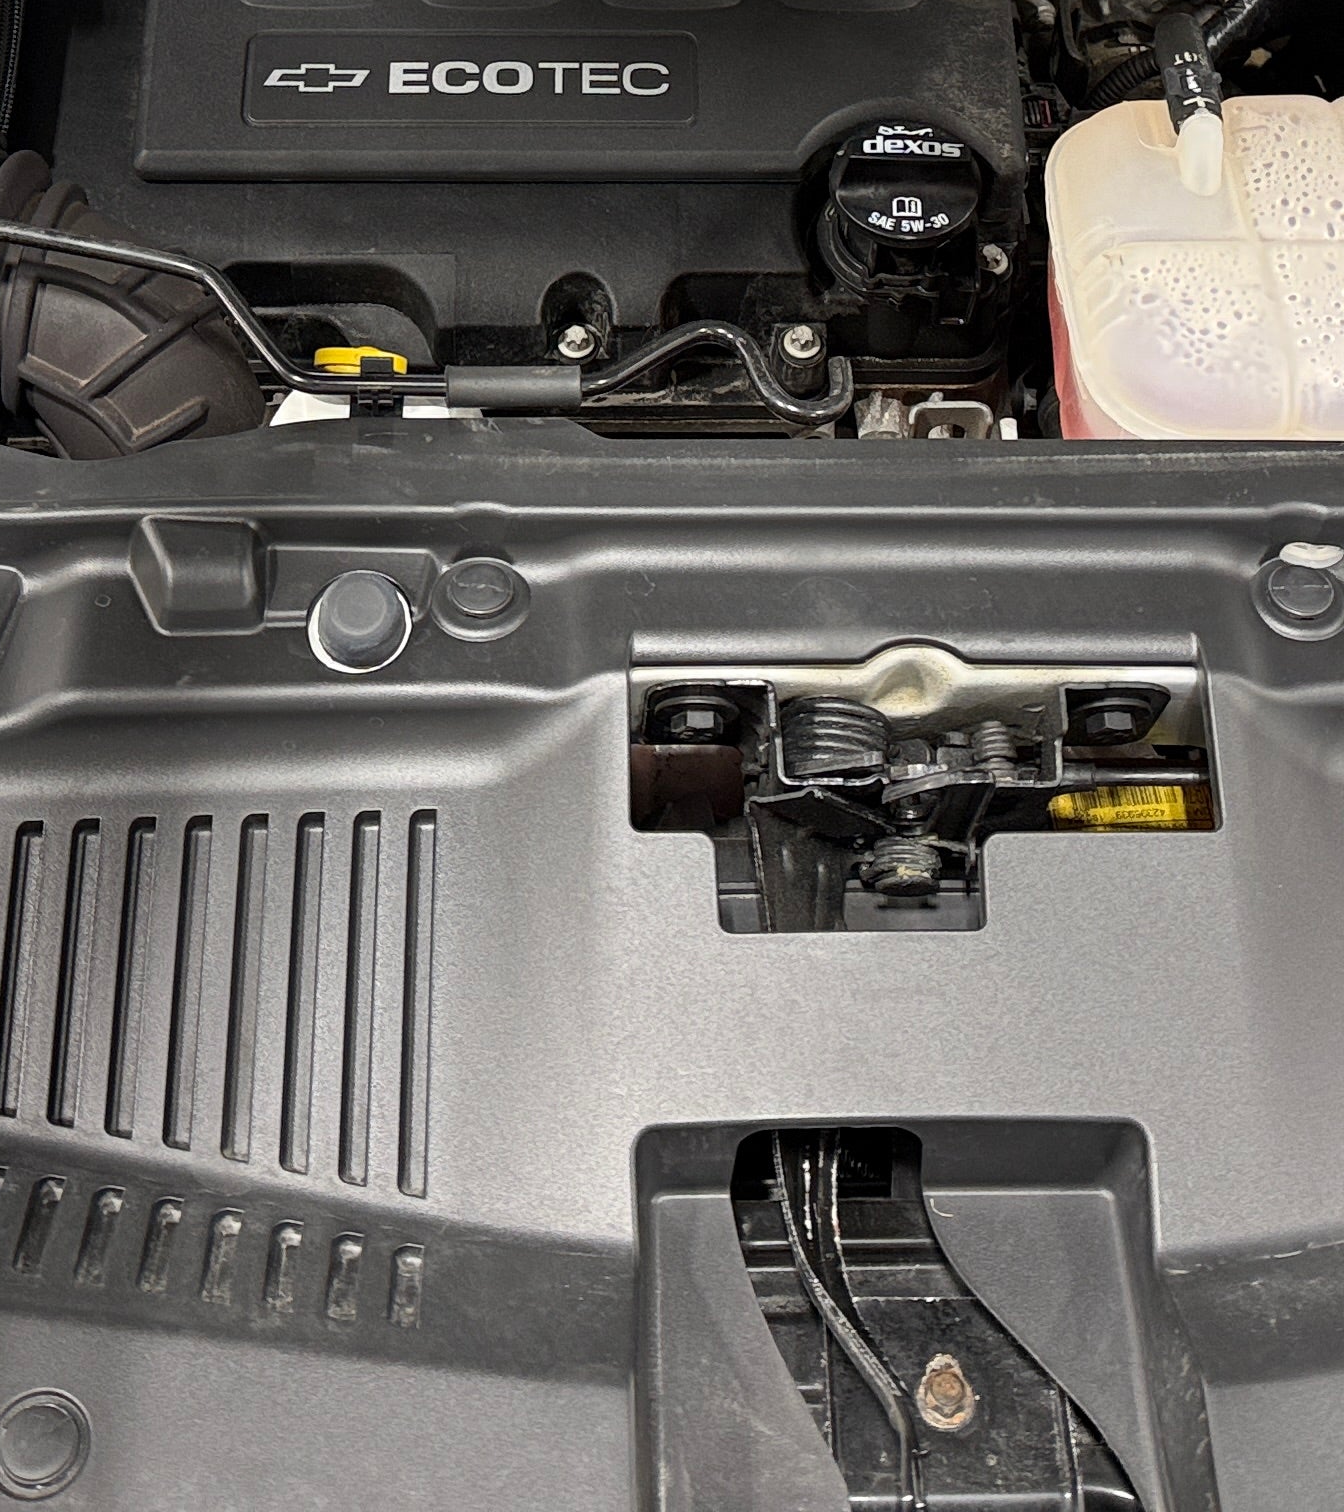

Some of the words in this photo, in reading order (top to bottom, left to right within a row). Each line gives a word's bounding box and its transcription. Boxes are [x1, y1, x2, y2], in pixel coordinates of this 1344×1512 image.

[387, 60, 672, 97] ECOTEC
[862, 134, 965, 158] dexos
[867, 211, 897, 231] SAE
[900, 213, 950, 233] 5W-30
